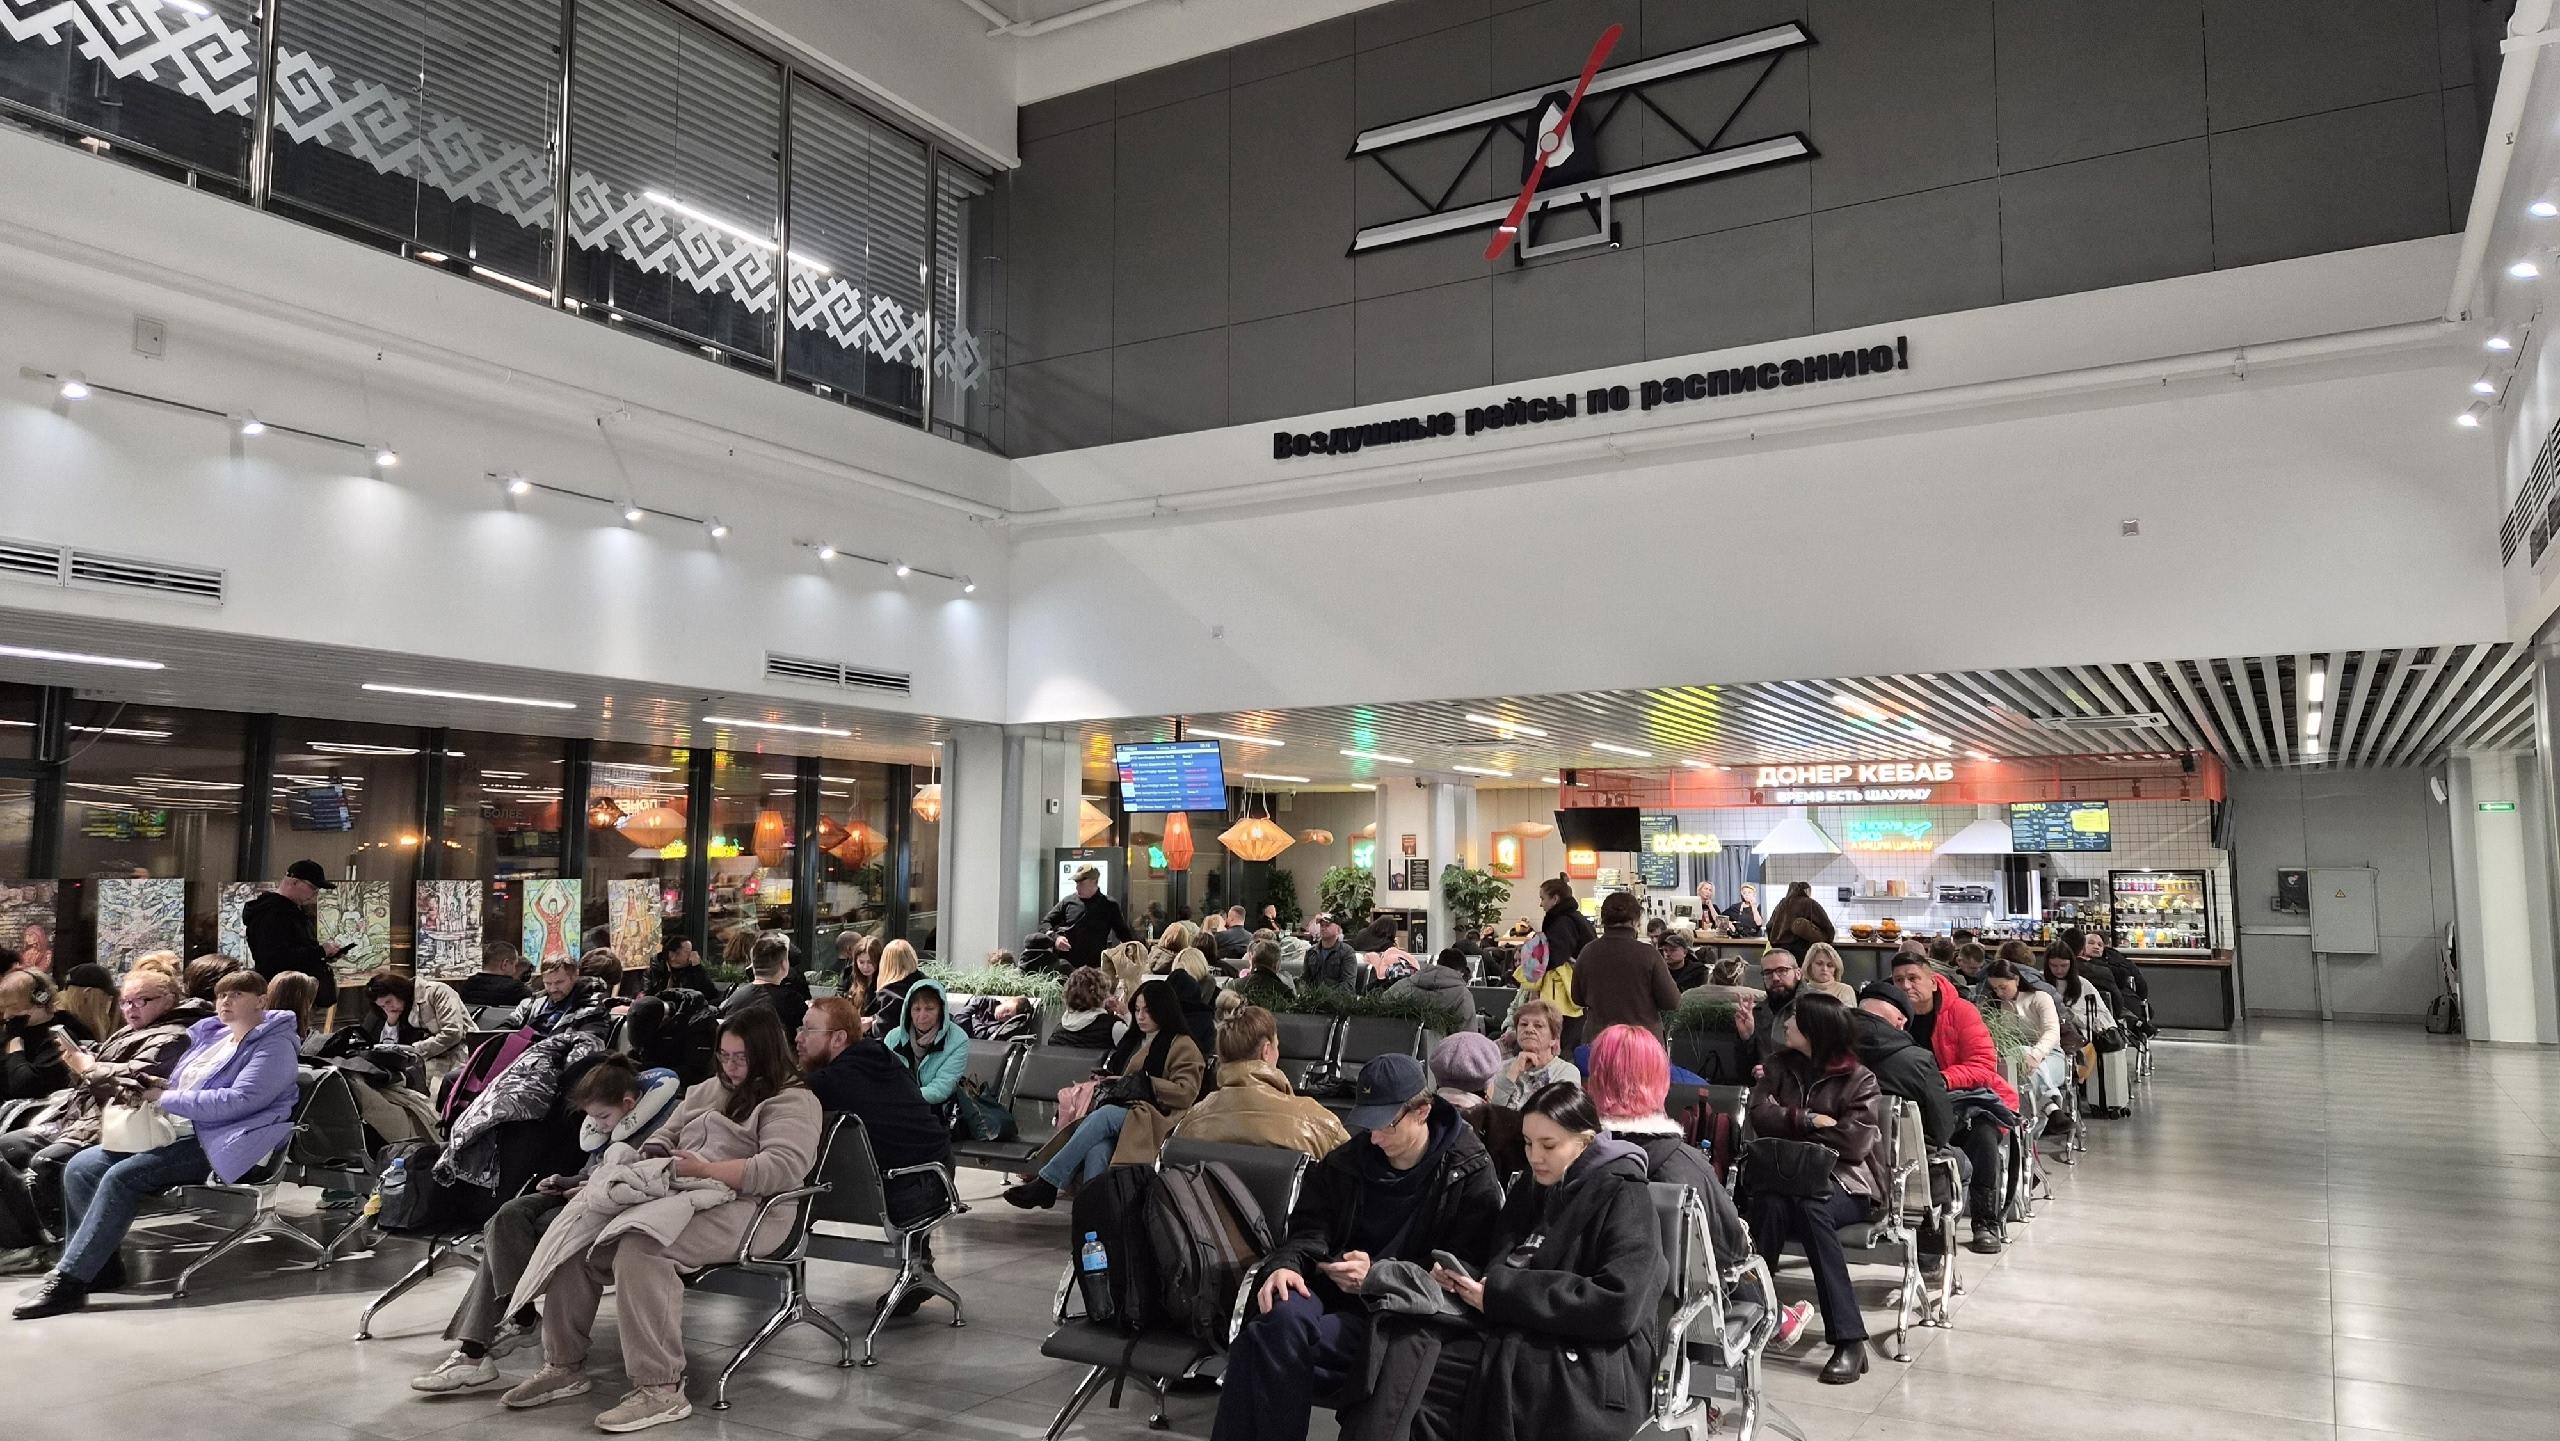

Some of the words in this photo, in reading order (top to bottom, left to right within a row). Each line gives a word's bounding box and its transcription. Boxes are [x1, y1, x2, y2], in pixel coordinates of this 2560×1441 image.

[1273, 411, 1456, 460] Воздушные
[1465, 394, 1576, 435] рейсы
[1586, 387, 1630, 415] по
[1641, 336, 1909, 410] расписанию!
[1757, 766, 1853, 787] ДОНЕР
[1859, 763, 1954, 782] КЕБАБ
[1827, 790, 1863, 802] ЕСТЬ
[1865, 788, 1932, 801] ШАУРМУ
[2011, 803, 2047, 811] MENU
[1653, 834, 1722, 853] КАССА
